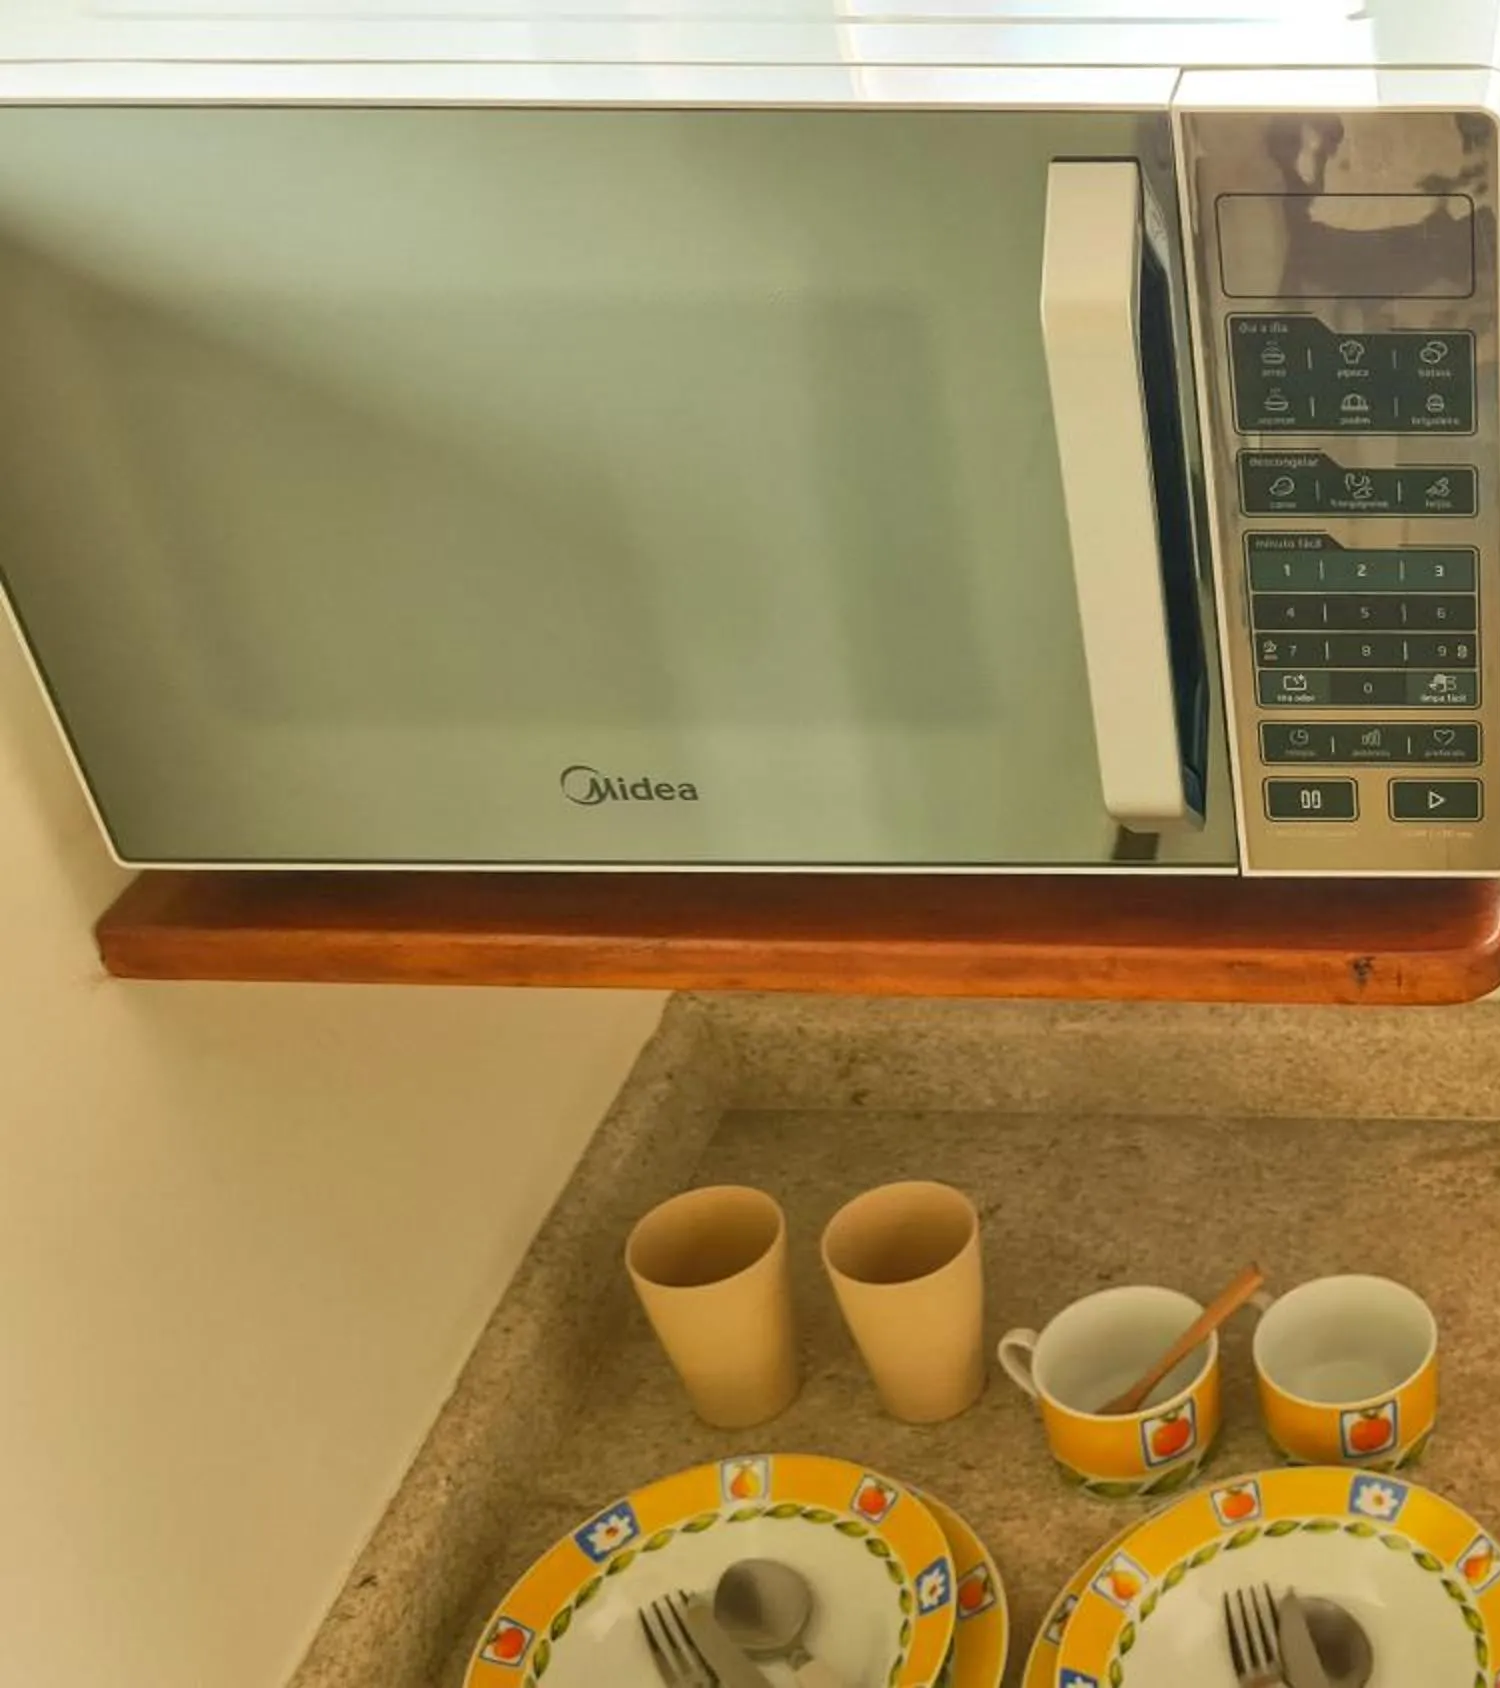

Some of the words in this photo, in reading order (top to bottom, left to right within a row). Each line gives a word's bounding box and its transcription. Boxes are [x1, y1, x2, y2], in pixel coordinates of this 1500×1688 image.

[1283, 563, 1291, 577] 1
[1356, 563, 1368, 577] 2
[1434, 564, 1445, 577] 3
[1285, 607, 1295, 618] 4
[1360, 607, 1370, 618] 5
[1436, 607, 1446, 619] 6
[1361, 645, 1371, 656] 8
[1437, 645, 1447, 657] 9
[561, 768, 698, 805] Midea
